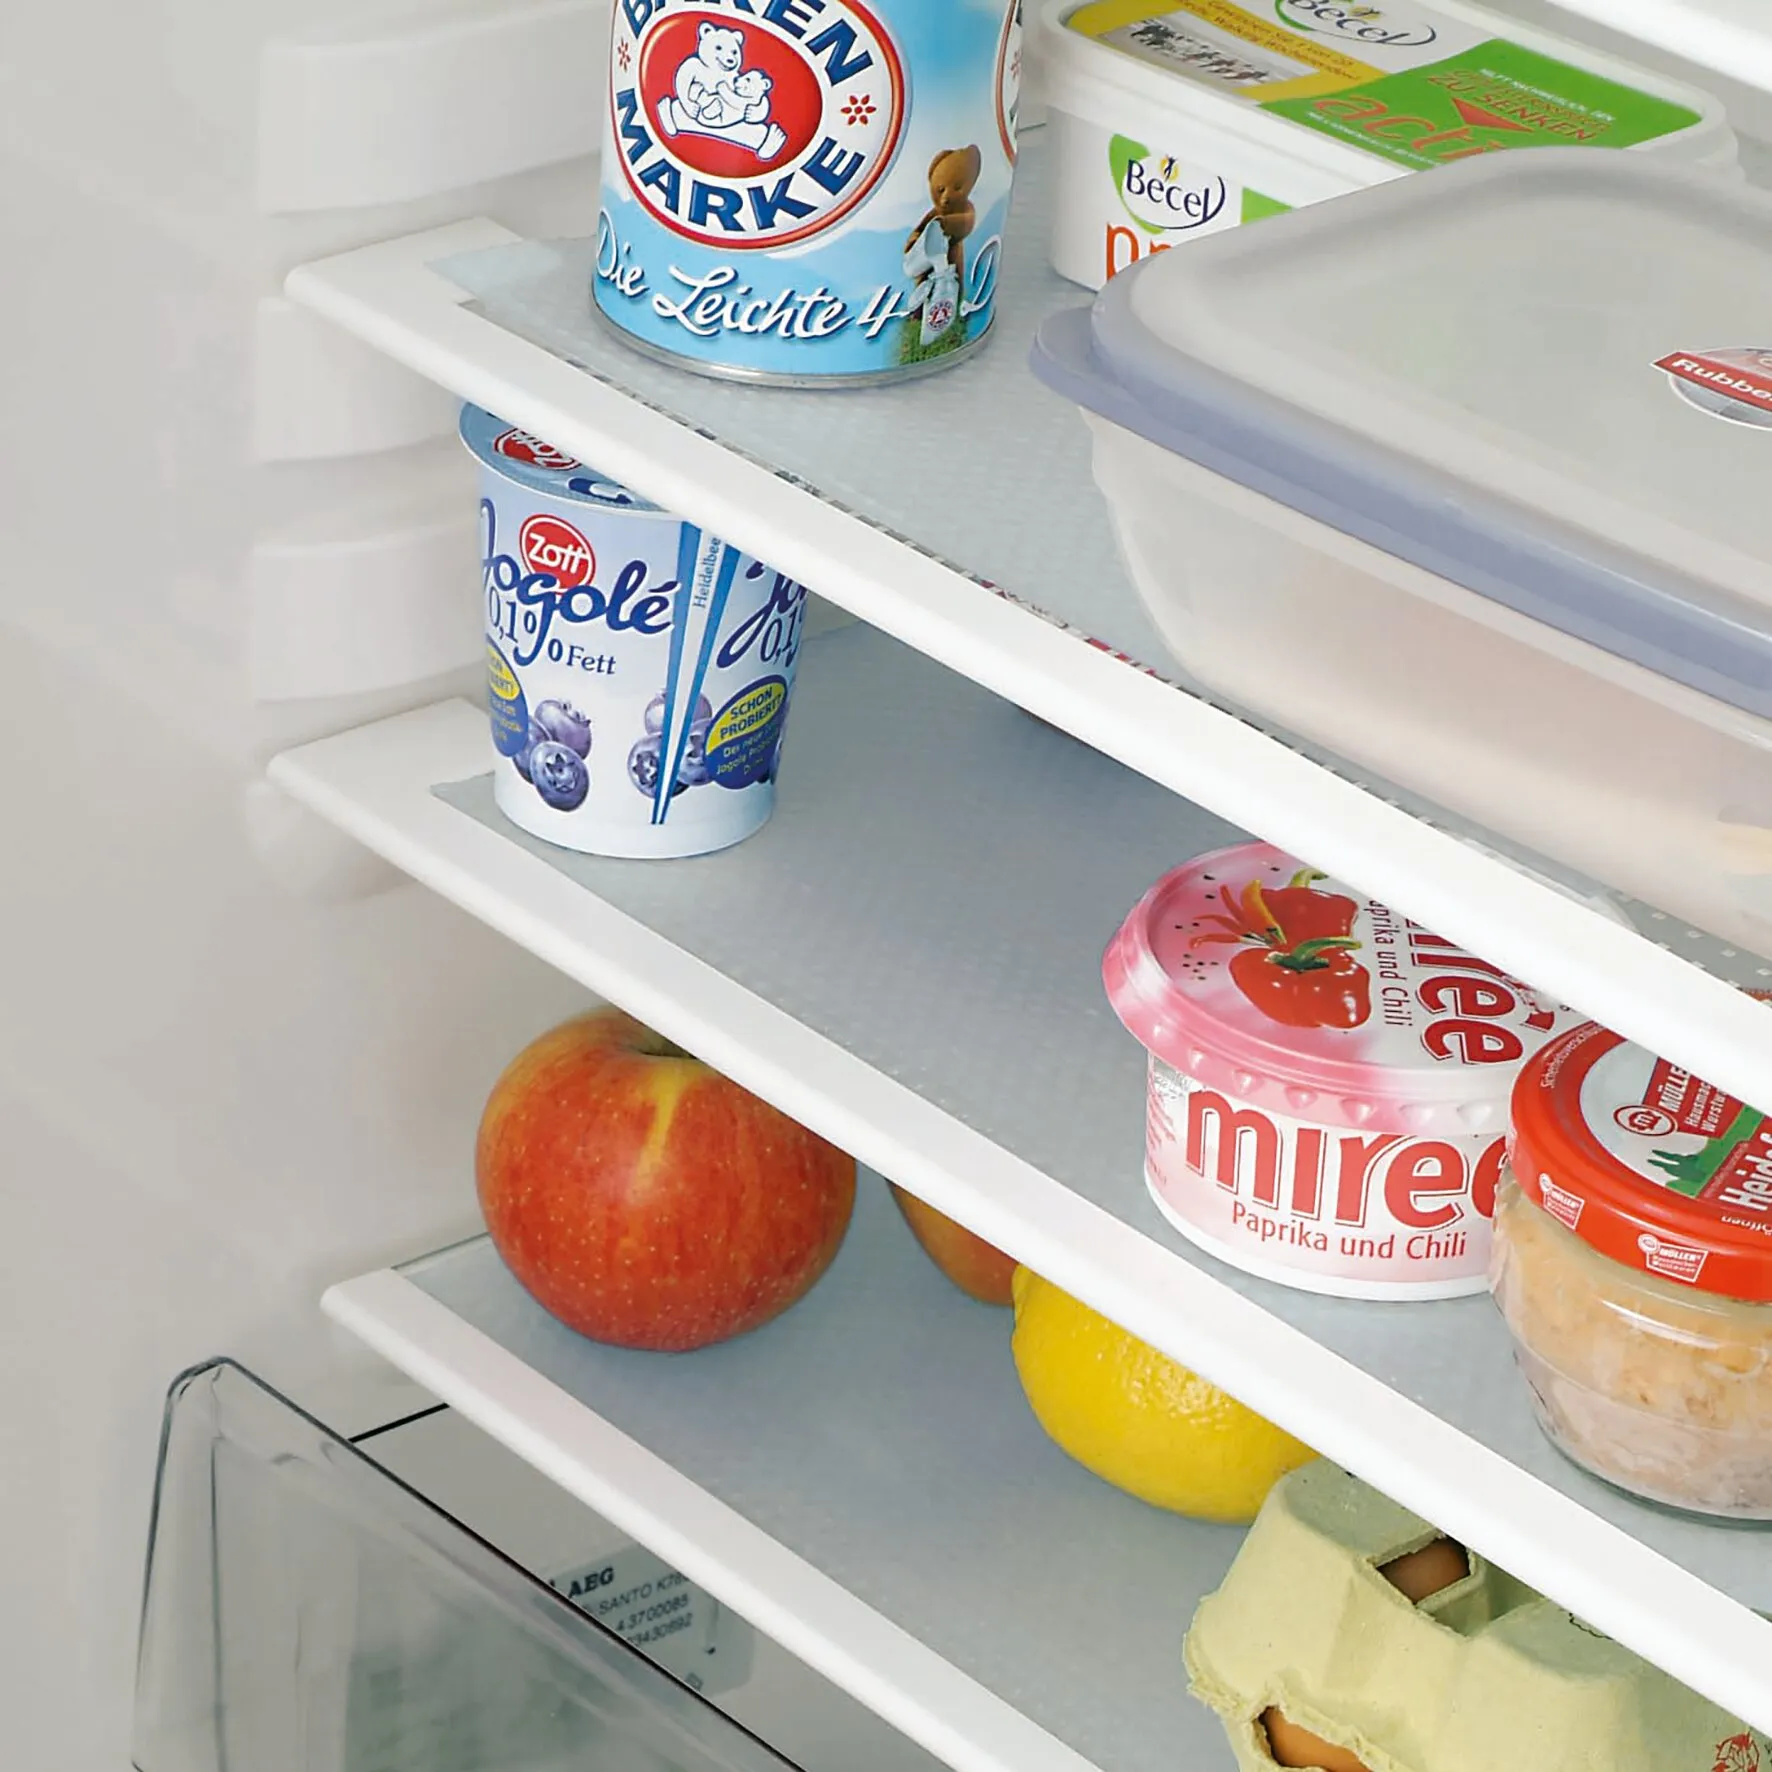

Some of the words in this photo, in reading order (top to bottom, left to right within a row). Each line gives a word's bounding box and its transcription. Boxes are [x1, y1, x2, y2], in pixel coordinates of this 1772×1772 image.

[620, 0, 874, 88] BEN
[1473, 92, 1598, 141] SENKEN
[615, 88, 866, 232] MARKE
[1125, 158, 1226, 223] Becel
[596, 206, 651, 299] Die
[651, 265, 855, 339] Leichte
[528, 532, 590, 575] Zott
[566, 645, 617, 675] Fett
[729, 686, 773, 721] SCHON
[1376, 951, 1408, 980] und
[1380, 986, 1413, 1027] Chili
[1232, 1200, 1329, 1253] Paprika
[1340, 1234, 1396, 1259] und
[1405, 1230, 1468, 1261] Chili
[568, 1566, 614, 1599] AEG
[599, 1583, 653, 1615] SANTO
